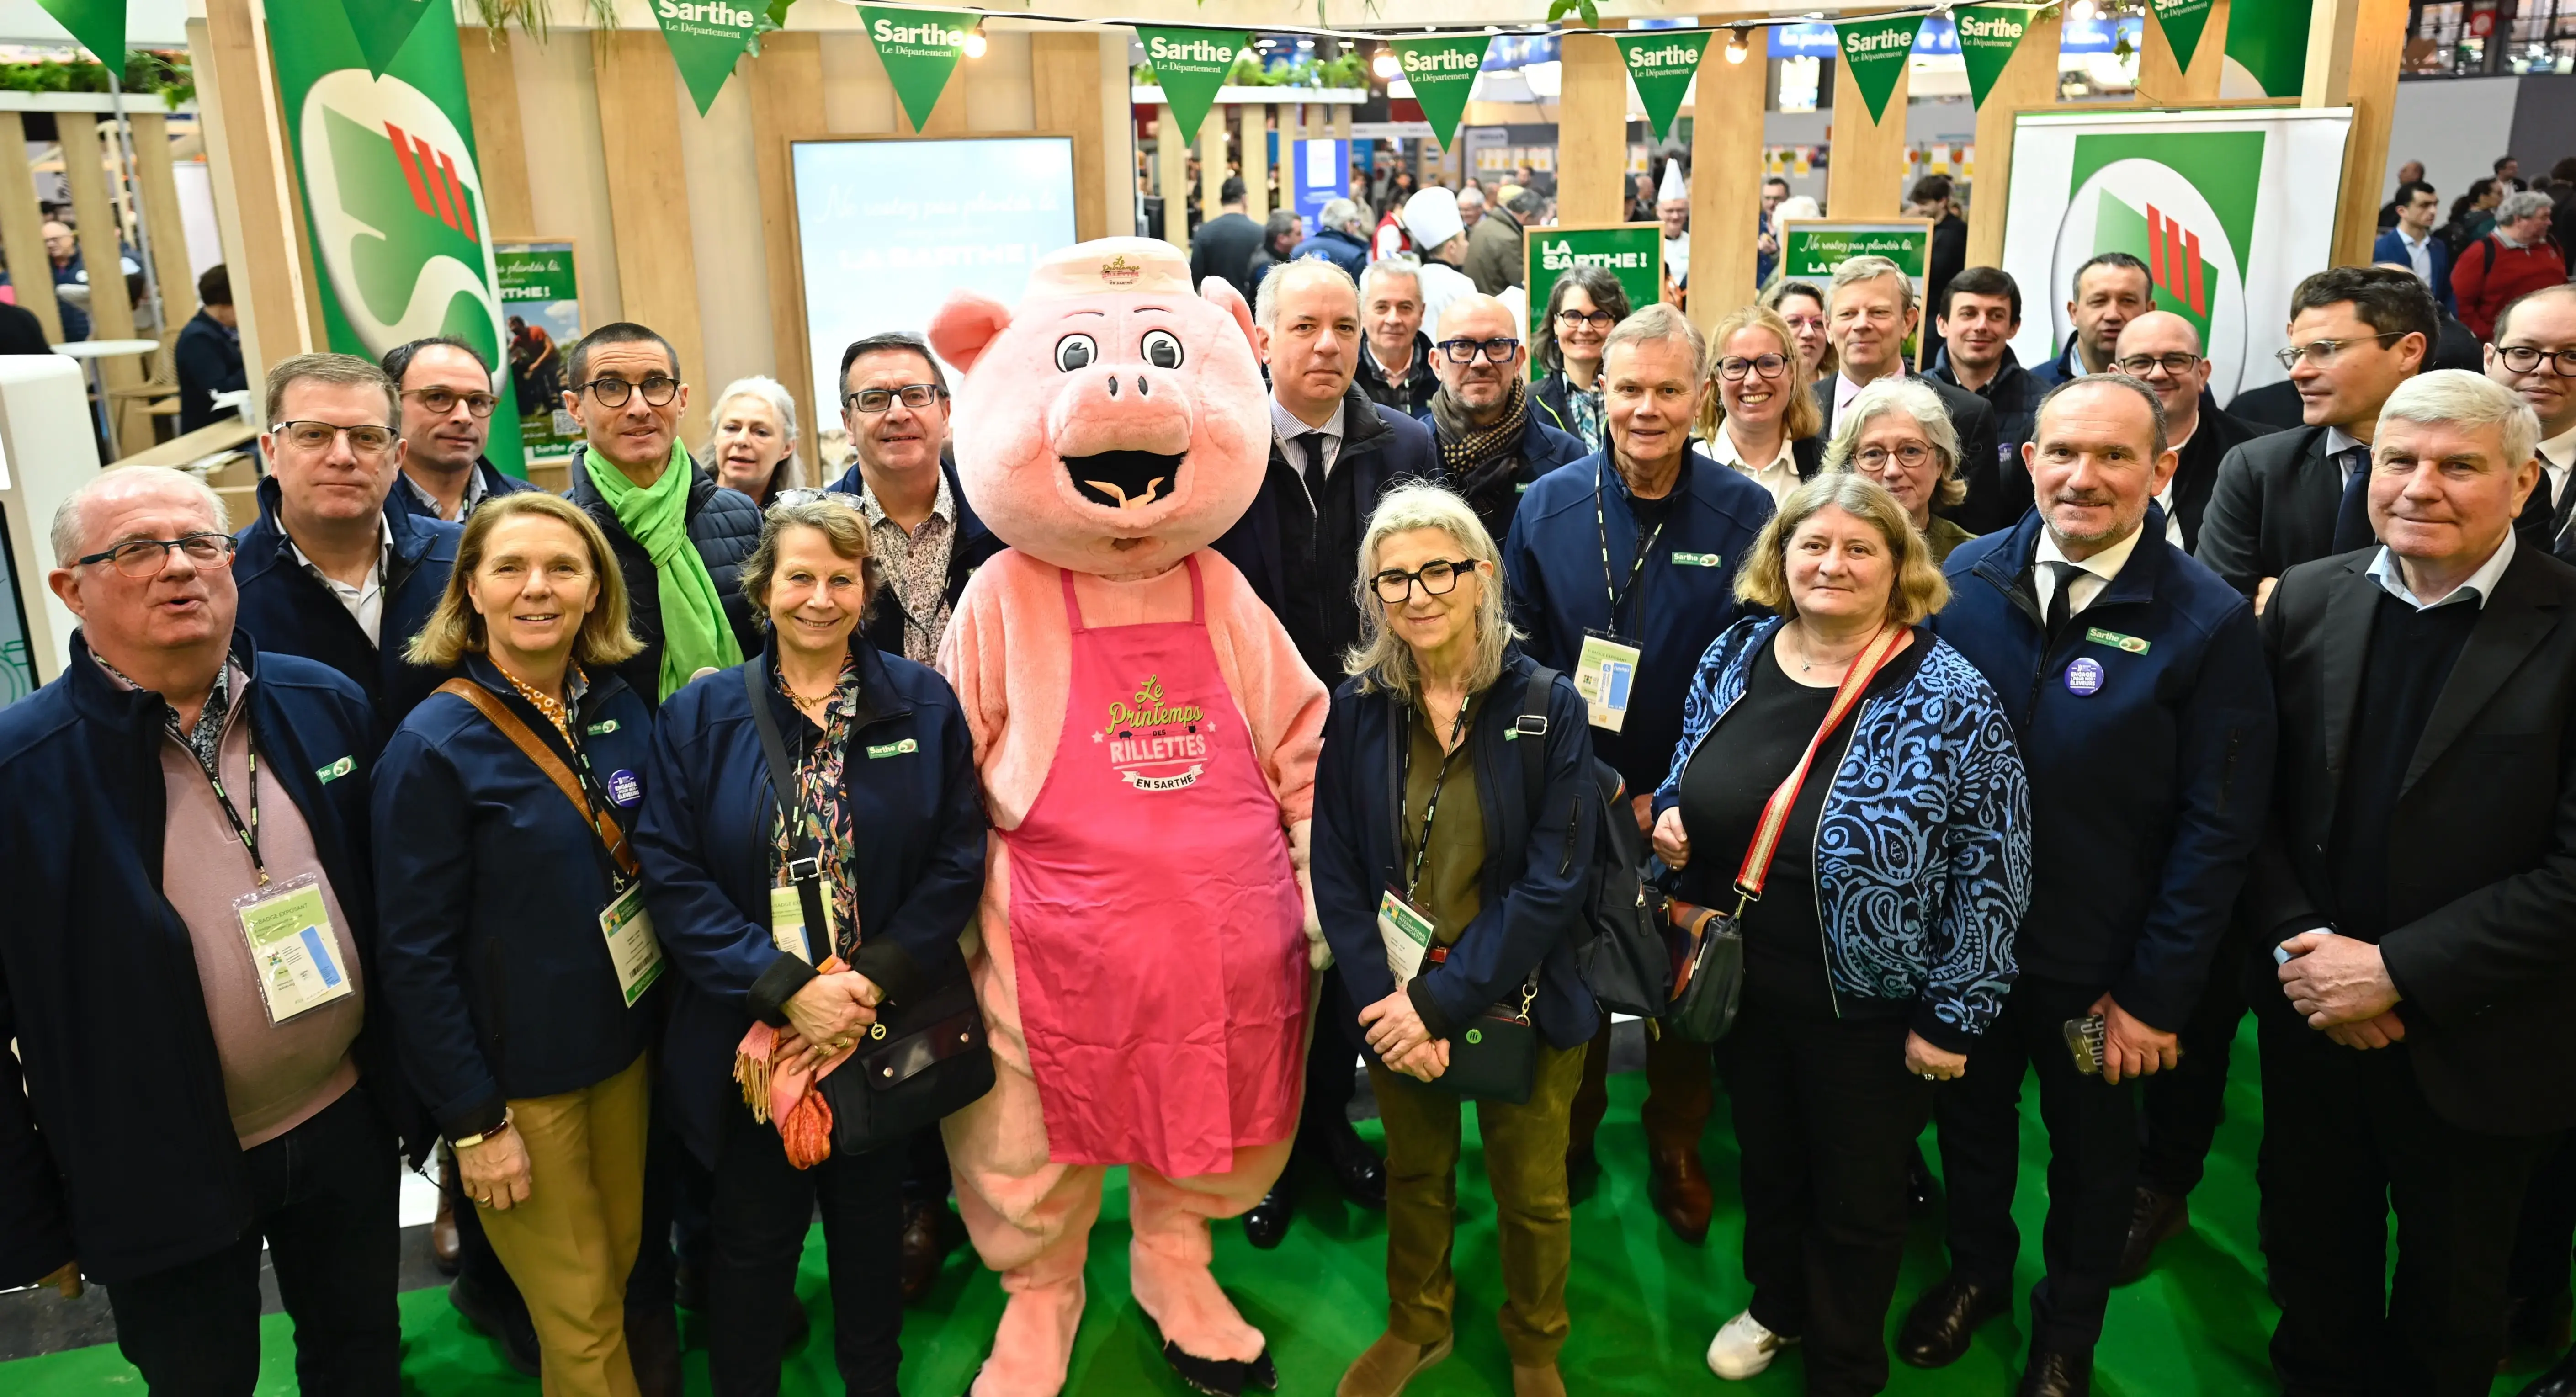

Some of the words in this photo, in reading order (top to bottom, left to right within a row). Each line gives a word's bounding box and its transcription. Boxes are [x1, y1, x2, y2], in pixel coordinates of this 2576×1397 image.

[658, 0, 754, 28] Sarthe
[666, 21, 678, 31] Le
[681, 23, 741, 39] Département
[874, 19, 964, 47] Sarthe
[1960, 16, 2023, 38] Sarthe
[1846, 28, 1912, 53] Sarthe
[882, 44, 893, 53] Le
[895, 45, 952, 57] Département
[1150, 37, 1232, 63] Sarthe
[1629, 44, 1698, 68] Sarthe
[1851, 54, 1860, 63] Le
[1861, 50, 1902, 62] Département
[1157, 61, 1167, 70] Le
[1169, 62, 1221, 73] Département
[1404, 49, 1479, 72] Sarthe
[1411, 74, 1421, 82] Le
[1423, 73, 1469, 83] Département
[1635, 69, 1644, 78] Le
[1646, 68, 1689, 78] Département
[1542, 240, 1572, 255] LA
[1800, 234, 1820, 252] Ne
[838, 248, 883, 270] LA
[1113, 255, 1125, 266] Le
[1542, 253, 1637, 270] SARTHE
[1807, 262, 1828, 273] LA
[1100, 264, 1141, 273] Printemps
[1674, 553, 1698, 561] Sarthe
[2090, 628, 2119, 642] Sarthe
[1134, 674, 1164, 704] Le
[1105, 701, 1204, 734] Printemps
[869, 746, 896, 754] Sarthe
[1110, 734, 1206, 763] RILLETTES
[1136, 778, 1151, 788] EN
[1154, 774, 1194, 789] SARTHE
[1398, 916, 1426, 940] INTERNATIONAL
